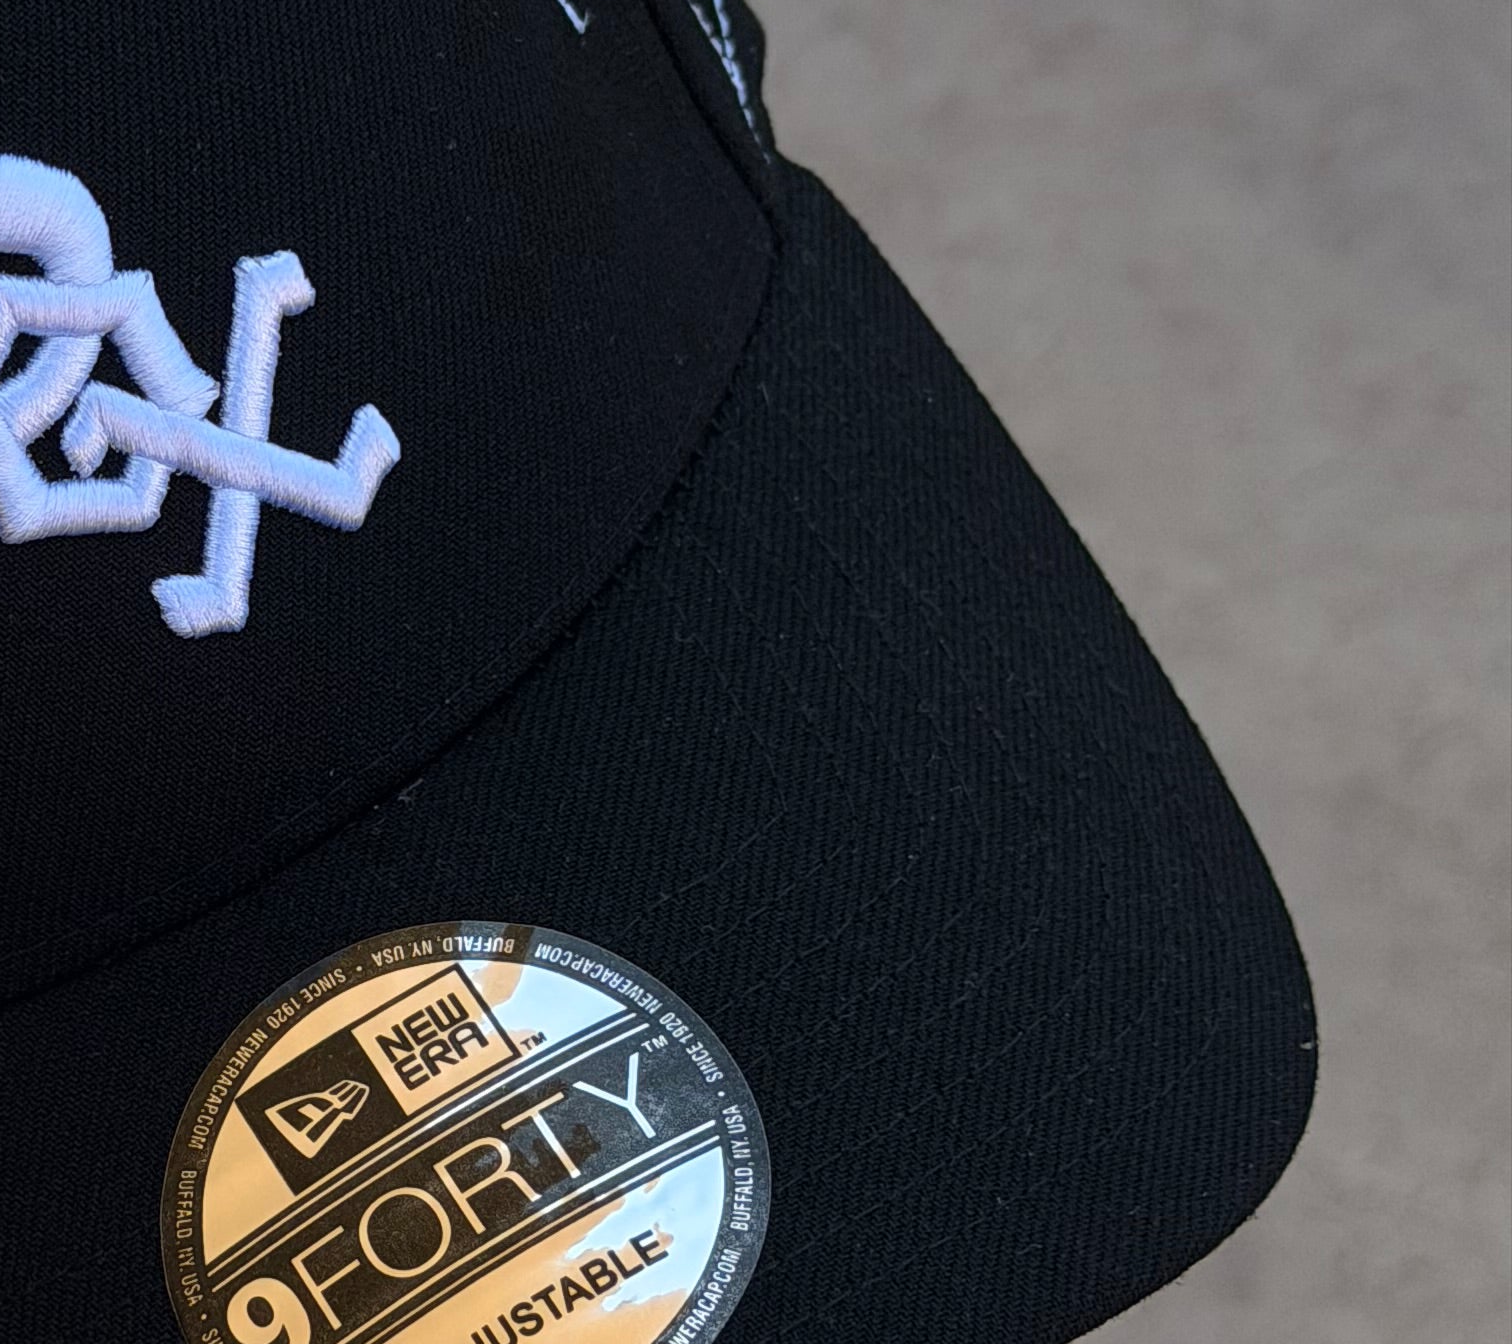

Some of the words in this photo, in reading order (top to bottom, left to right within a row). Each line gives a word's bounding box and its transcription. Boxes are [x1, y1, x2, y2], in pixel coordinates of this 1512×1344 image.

[370, 946, 405, 967] USA
[299, 967, 347, 1003] SINCE
[534, 942, 663, 1014] NEWERACAP.COM
[265, 997, 302, 1029] 1920
[375, 992, 470, 1063] NEW
[658, 1011, 694, 1044] 1920
[393, 1021, 489, 1091] ERA
[685, 1040, 724, 1083] SINCE
[187, 1028, 269, 1150] NEWERACAP.COM
[722, 1104, 747, 1134] USA
[181, 1273, 204, 1307] USA
